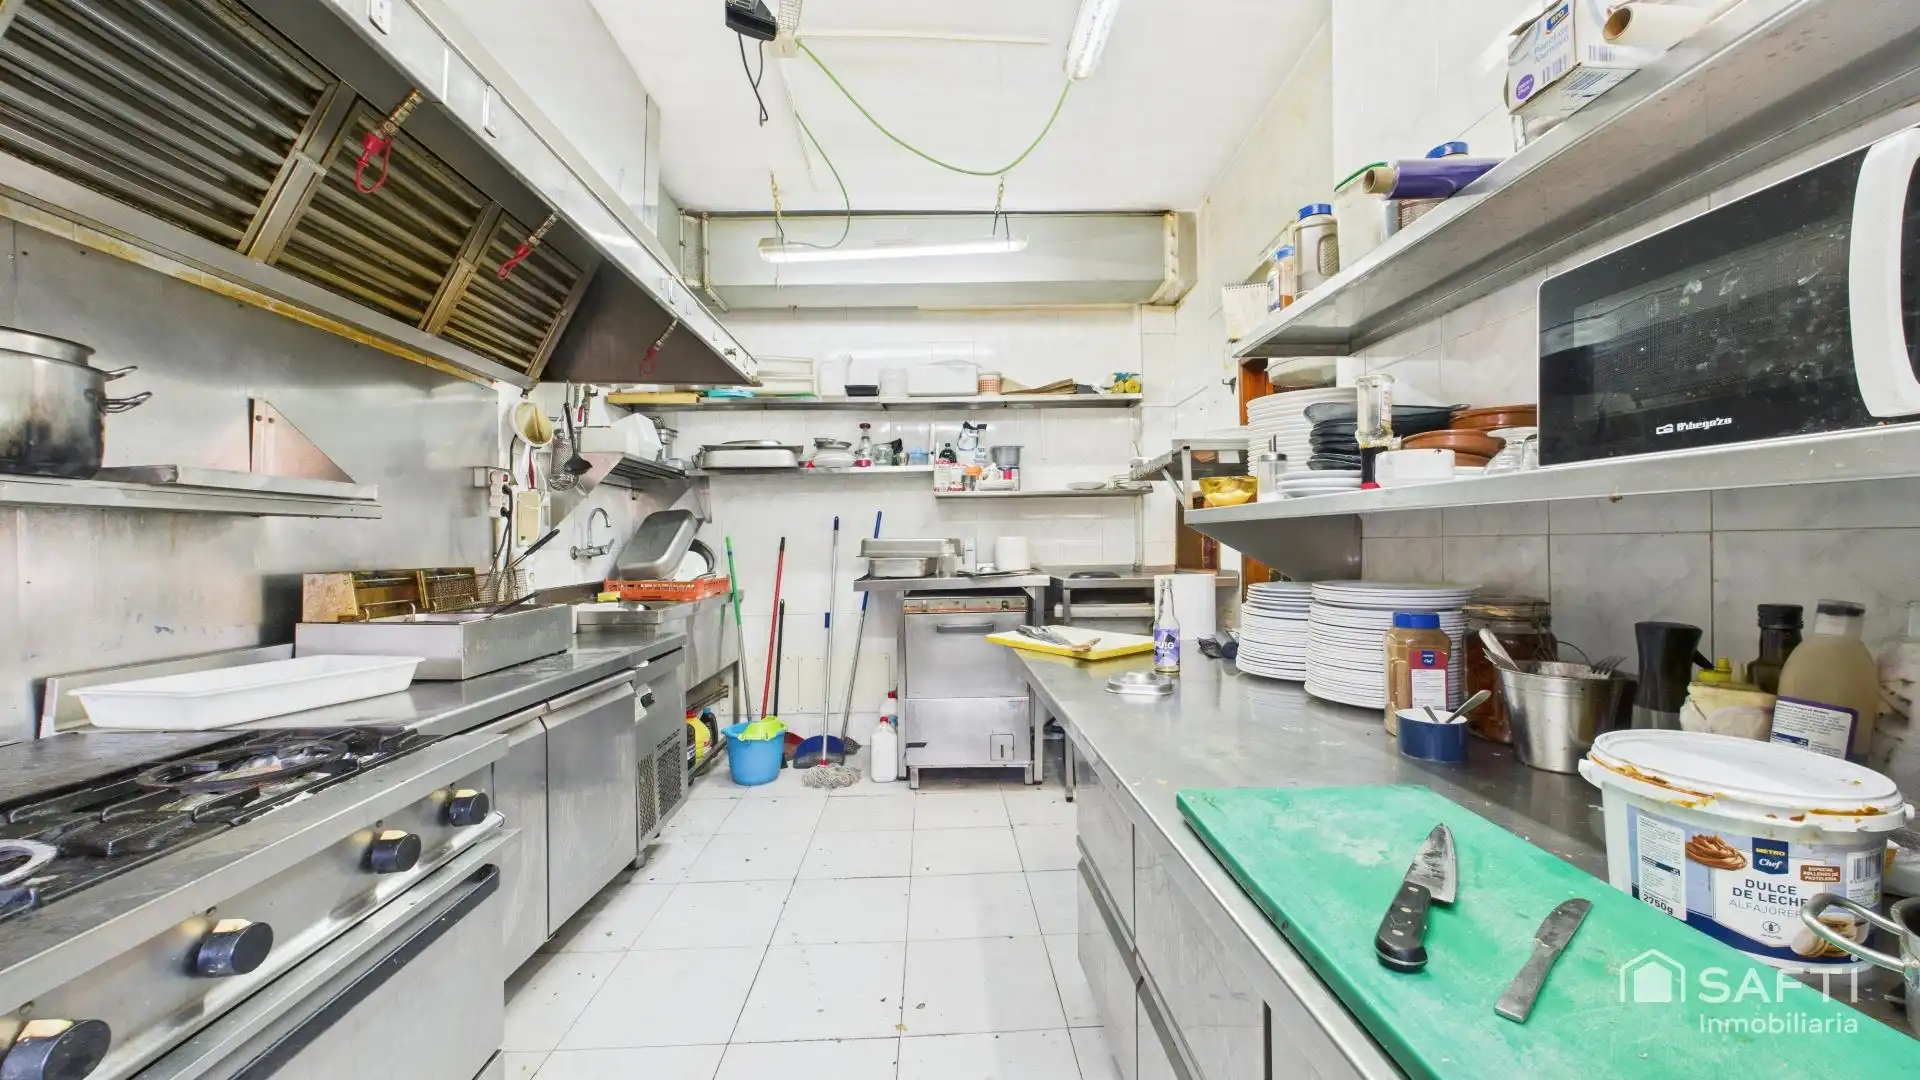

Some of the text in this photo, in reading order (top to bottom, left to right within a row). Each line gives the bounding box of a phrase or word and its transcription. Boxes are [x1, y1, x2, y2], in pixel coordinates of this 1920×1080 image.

[1755, 847, 1786, 857] METRO
[1758, 858, 1783, 869] Chef
[1732, 887, 1753, 899] DE
[1745, 879, 1797, 895] DULCE
[1643, 893, 1674, 915] 2750g
[1729, 899, 1801, 918] ALFAJORER
